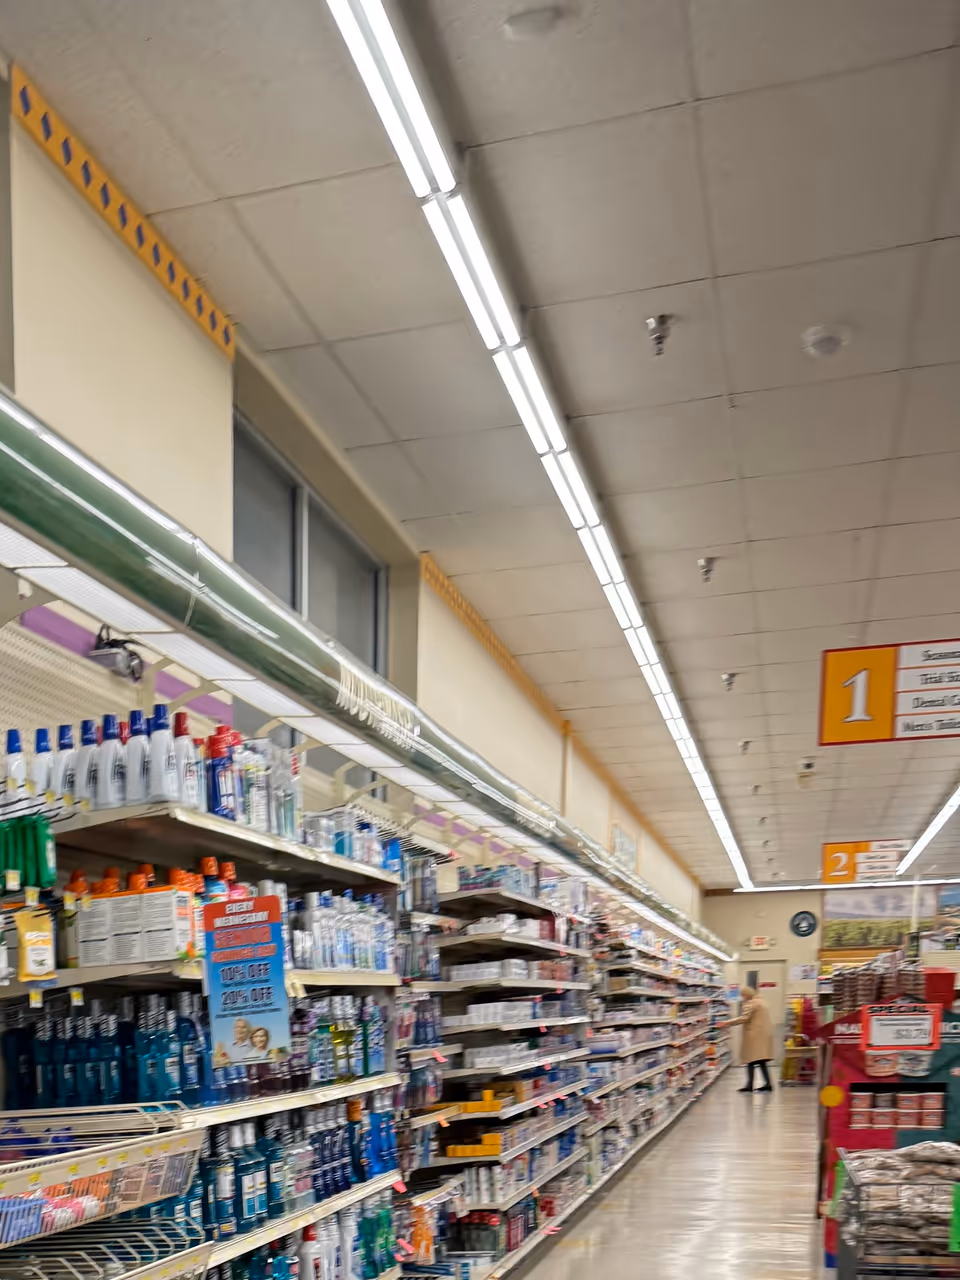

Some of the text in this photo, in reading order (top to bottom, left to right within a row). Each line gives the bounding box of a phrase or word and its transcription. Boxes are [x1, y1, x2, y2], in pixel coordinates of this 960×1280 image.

[842, 667, 874, 723] 1
[828, 852, 849, 876] 2
[225, 900, 255, 914] EVERY
[213, 911, 270, 928] WEDNESDAY
[220, 962, 272, 982] 10% OFF
[221, 985, 274, 1006] 20% OFF
[868, 1005, 930, 1014] SPECIAL
